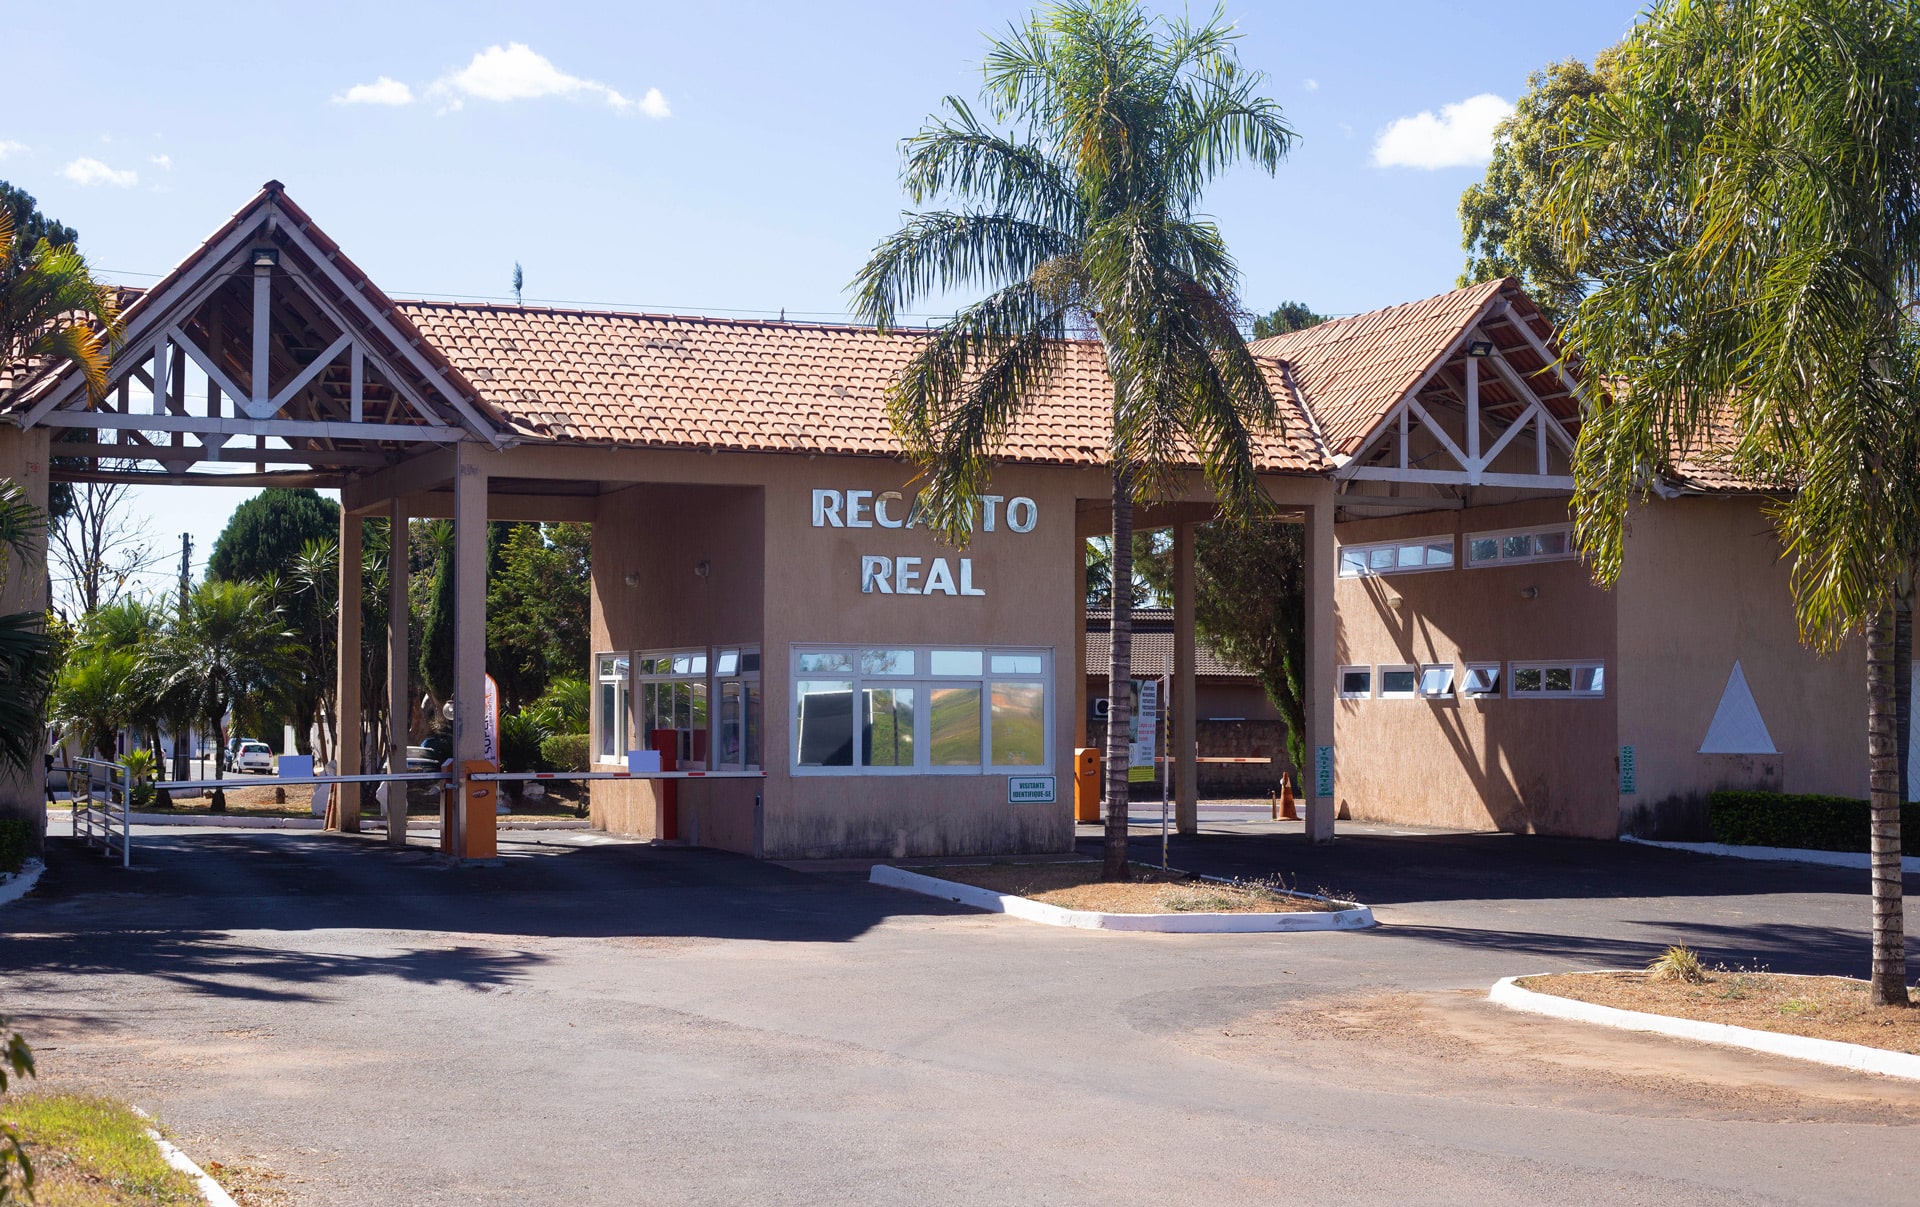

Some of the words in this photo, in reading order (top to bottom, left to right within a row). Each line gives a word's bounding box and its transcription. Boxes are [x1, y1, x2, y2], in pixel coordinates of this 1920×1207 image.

[860, 554, 986, 596] REAL
[1019, 782, 1046, 790] VISITANTE
[1012, 791, 1052, 799] IDENTIFIQUE-SE
